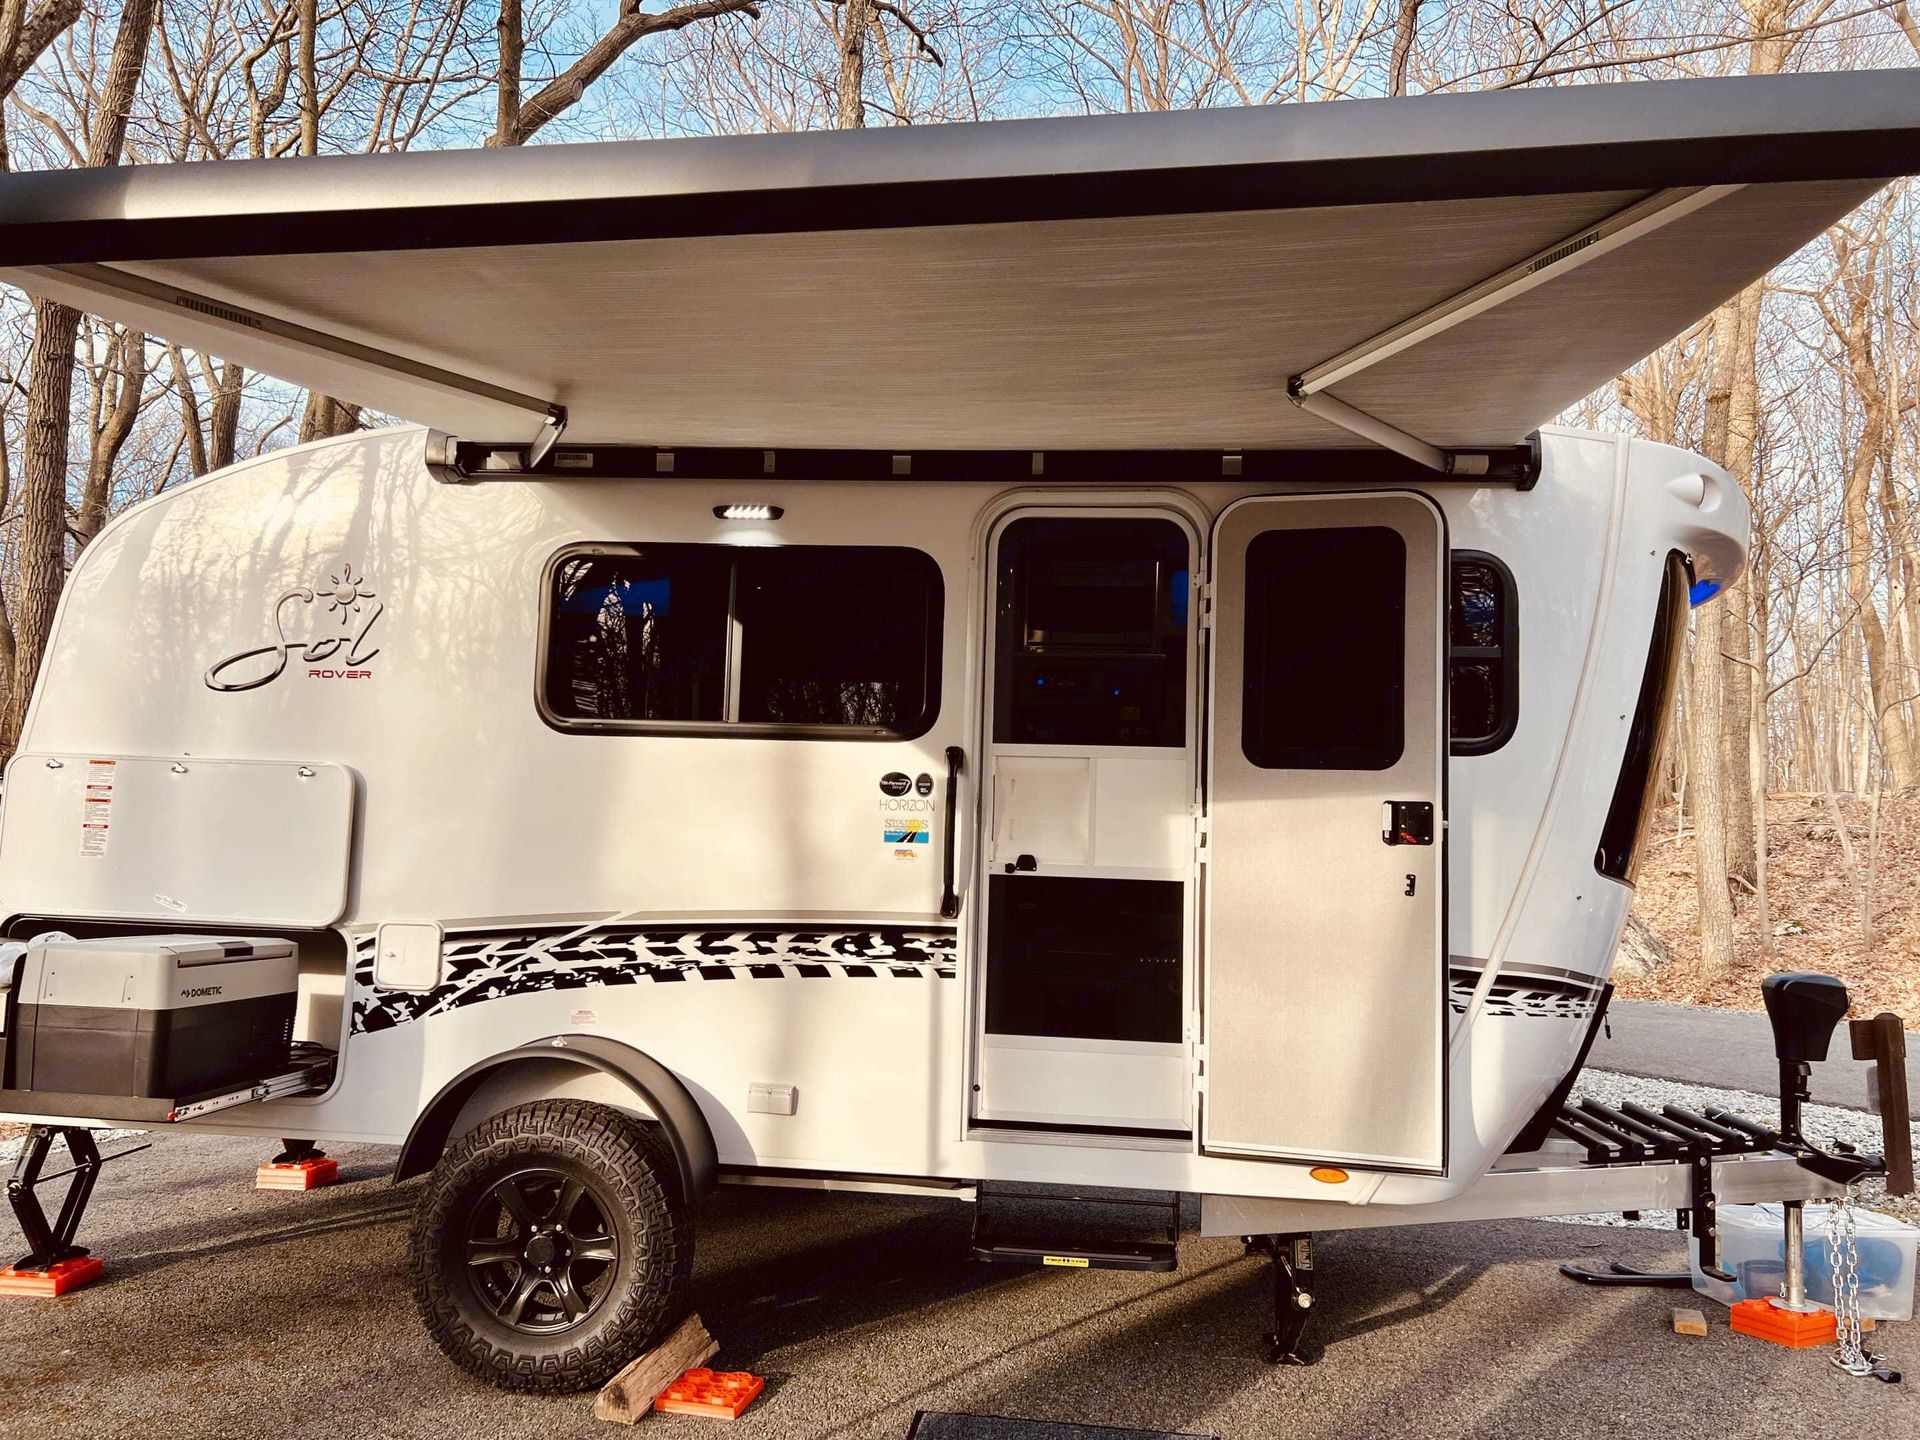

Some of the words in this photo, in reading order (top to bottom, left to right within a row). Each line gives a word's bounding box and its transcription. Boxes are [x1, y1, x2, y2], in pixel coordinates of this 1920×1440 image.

[204, 587, 384, 692] Sol
[308, 669, 372, 679] ROVER
[879, 799, 935, 812] HORIZON
[191, 985, 223, 998] DOMETIC
